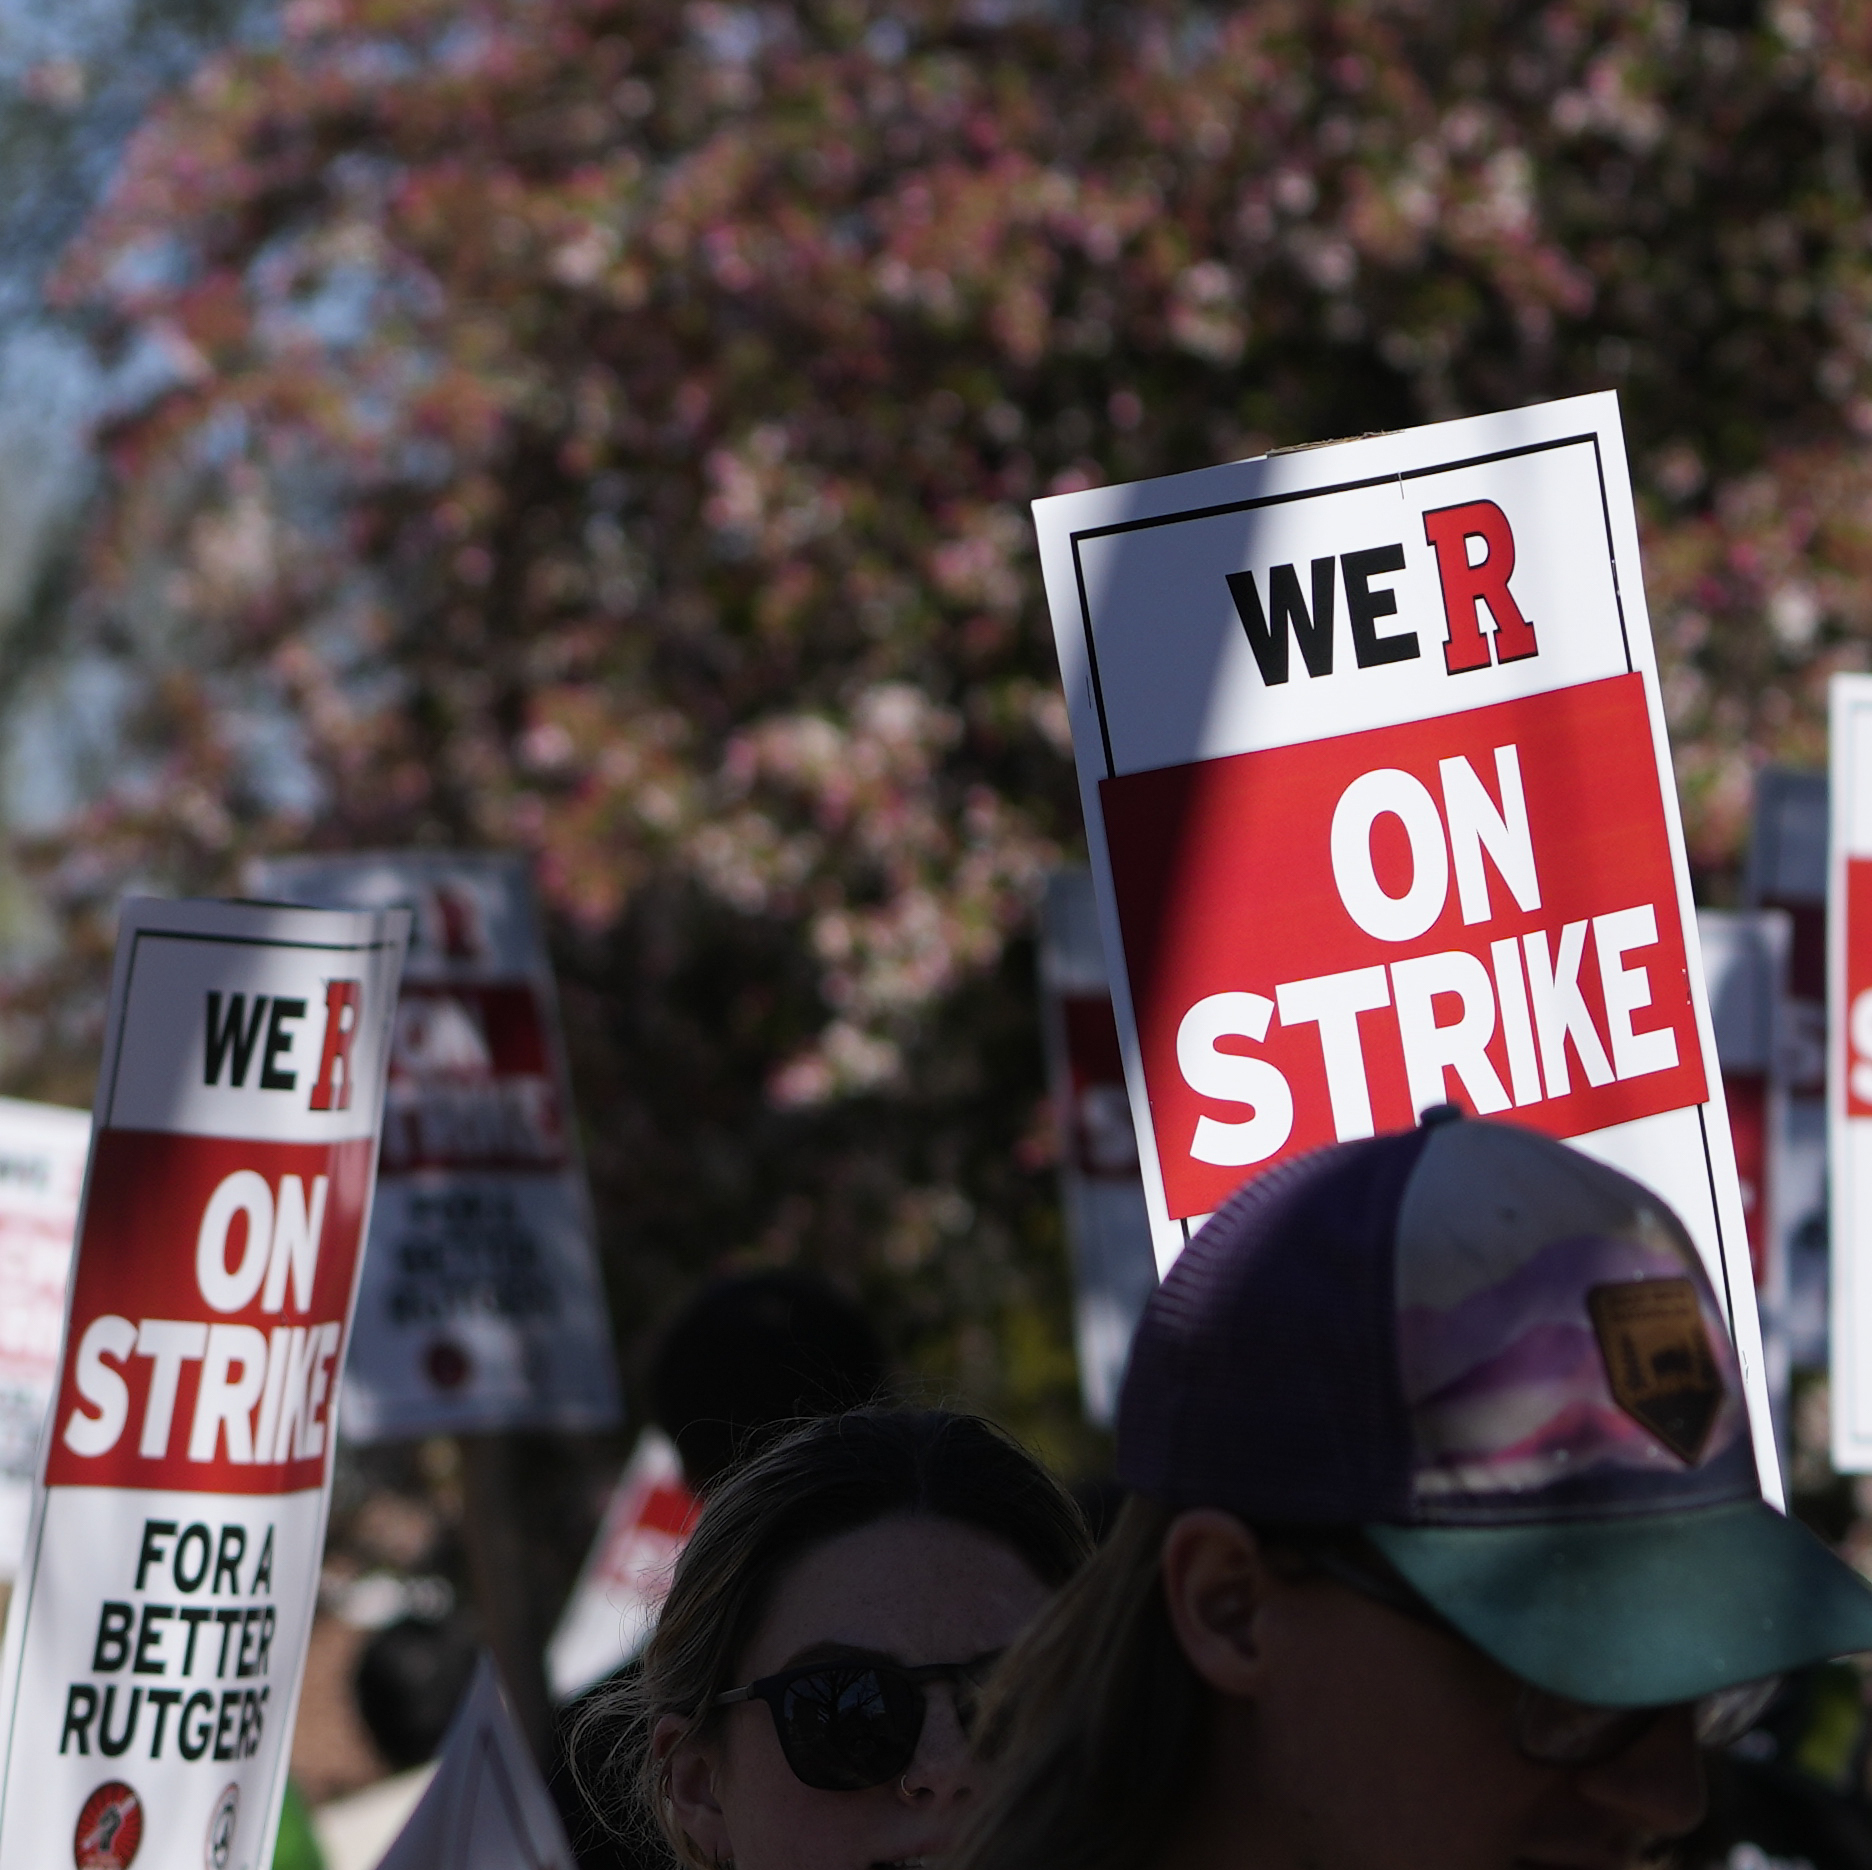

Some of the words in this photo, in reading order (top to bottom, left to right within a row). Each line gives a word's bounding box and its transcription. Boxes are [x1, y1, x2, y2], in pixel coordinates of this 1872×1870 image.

[1225, 542, 1420, 688] WE
[1422, 498, 1539, 676] R
[1331, 743, 1541, 942] ON
[203, 989, 308, 1090] WE
[309, 980, 363, 1110] R
[1176, 903, 1679, 1168] STRIKE
[196, 1168, 329, 1315] ON
[62, 1314, 341, 1465] STRIKE
[133, 1518, 247, 1595] FOR
[250, 1521, 276, 1596] A
[92, 1599, 277, 1680] BETTER
[59, 1683, 271, 1762] RUTGERS
